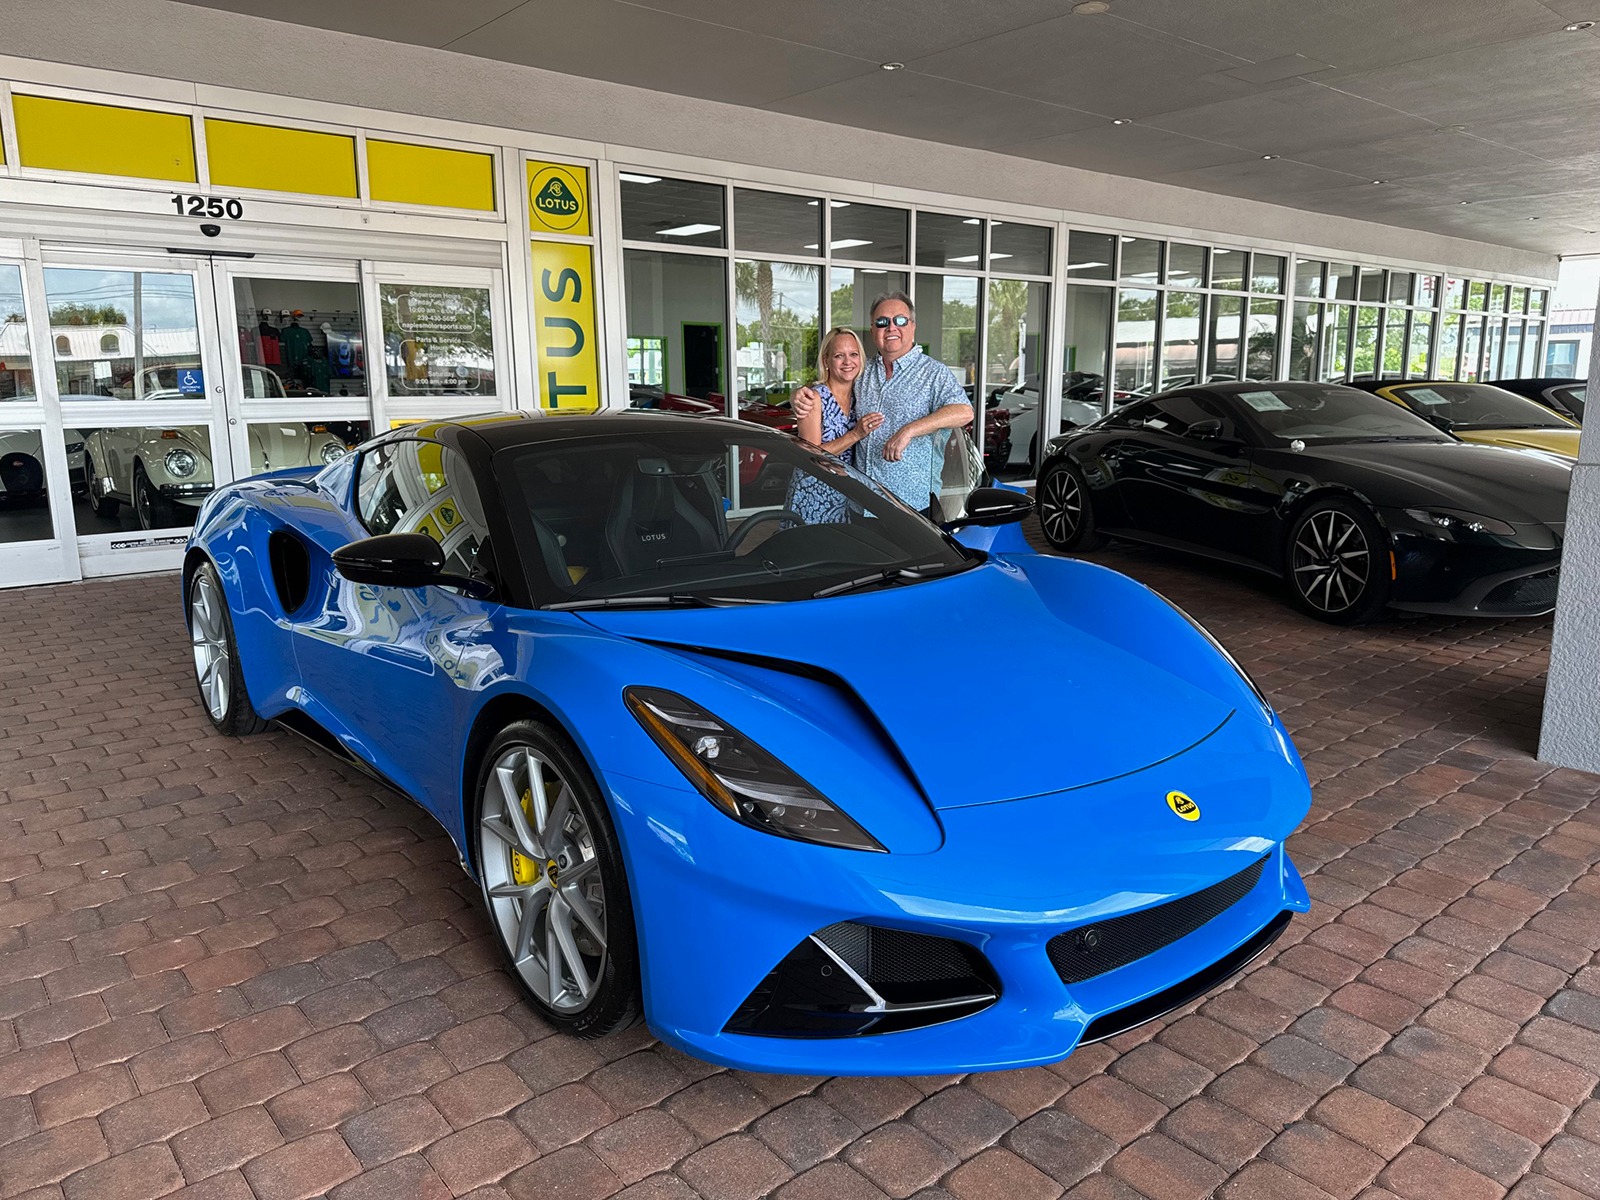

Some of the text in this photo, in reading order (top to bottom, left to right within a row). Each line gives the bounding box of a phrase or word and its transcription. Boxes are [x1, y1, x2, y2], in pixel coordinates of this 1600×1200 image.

[171, 194, 243, 220] 1250
[539, 197, 577, 211] LOTUS
[641, 533, 666, 542] LOTUS
[1177, 802, 1195, 813] LOTUS
